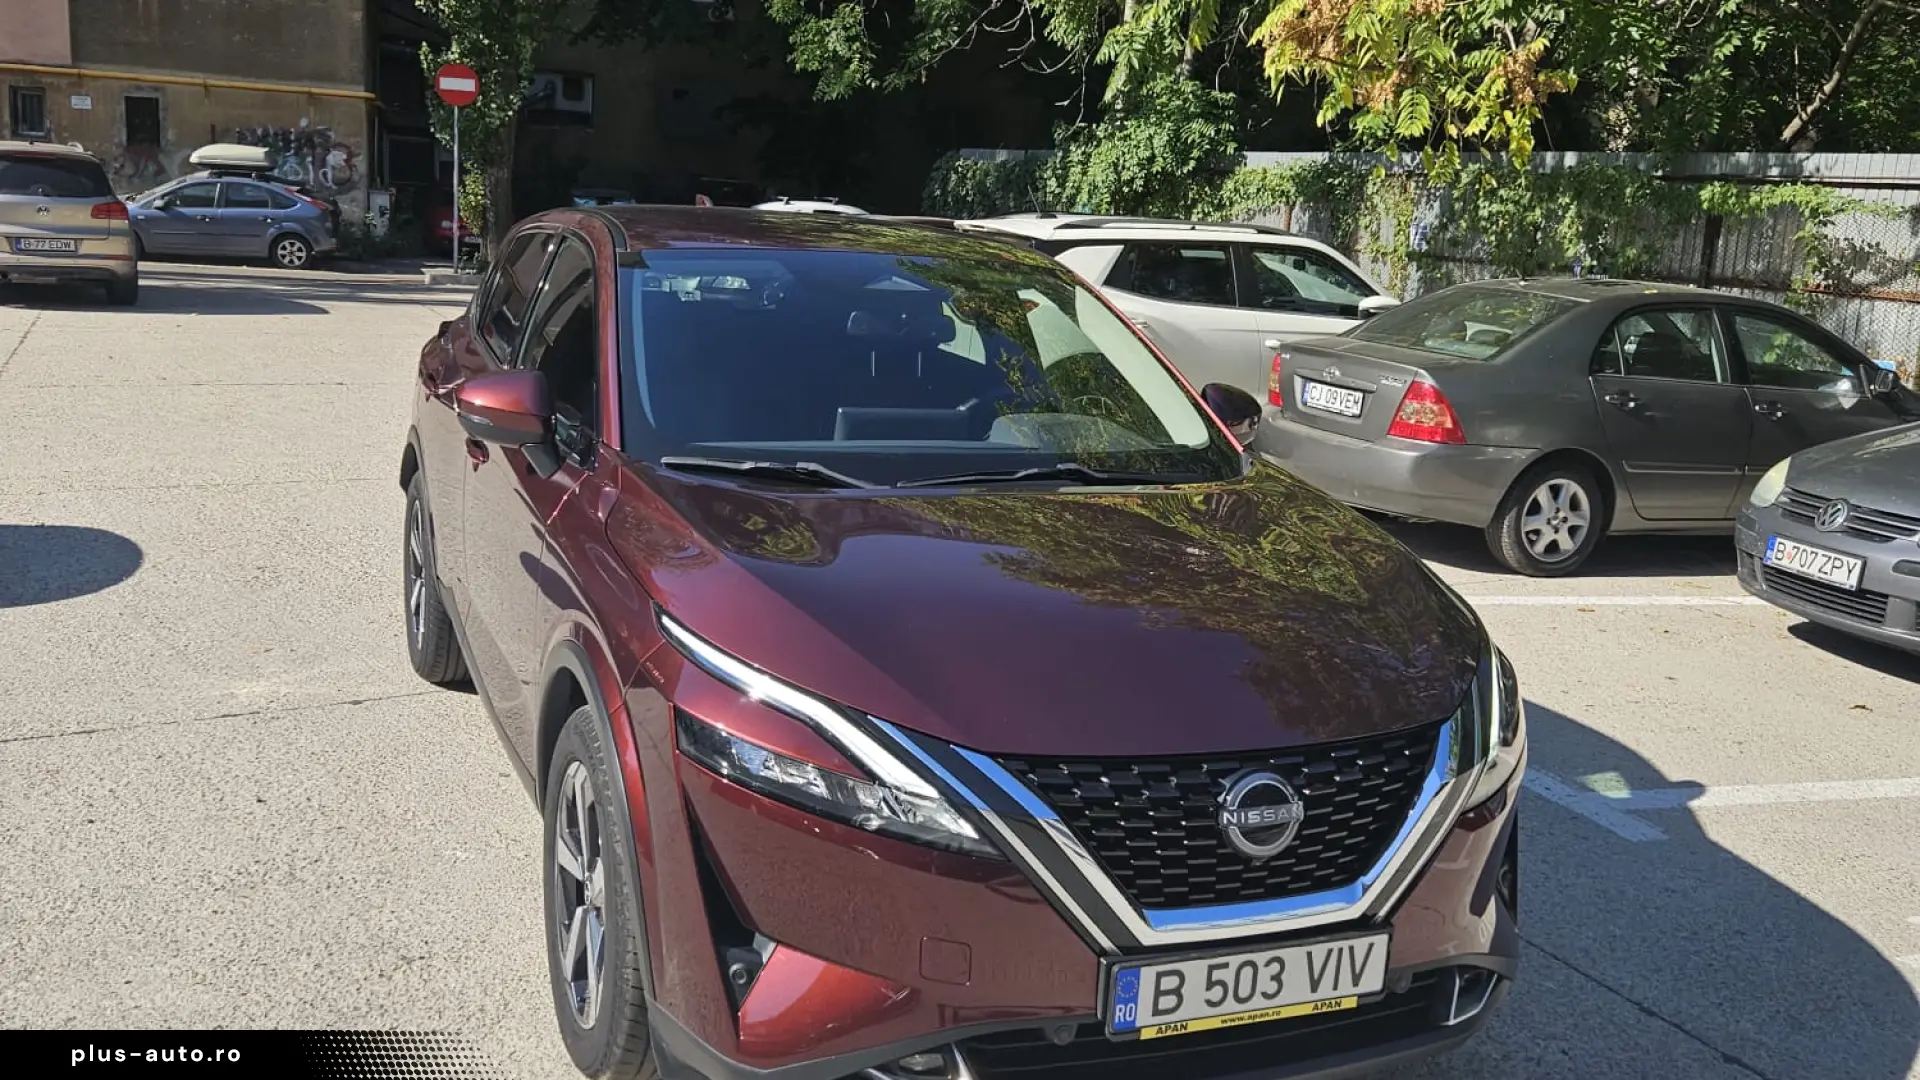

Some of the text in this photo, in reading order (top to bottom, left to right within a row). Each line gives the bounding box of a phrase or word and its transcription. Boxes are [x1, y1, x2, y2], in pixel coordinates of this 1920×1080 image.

[1310, 385, 1323, 402] CJ
[1325, 388, 1339, 405] 09
[1774, 541, 1858, 581] B 707 ZPY
[1223, 804, 1302, 824] NISSAN
[1151, 942, 1375, 1017] B 503 VIV
[1115, 1003, 1136, 1023] RO
[1155, 1021, 1189, 1036] APAN
[1312, 999, 1343, 1013] APAN
